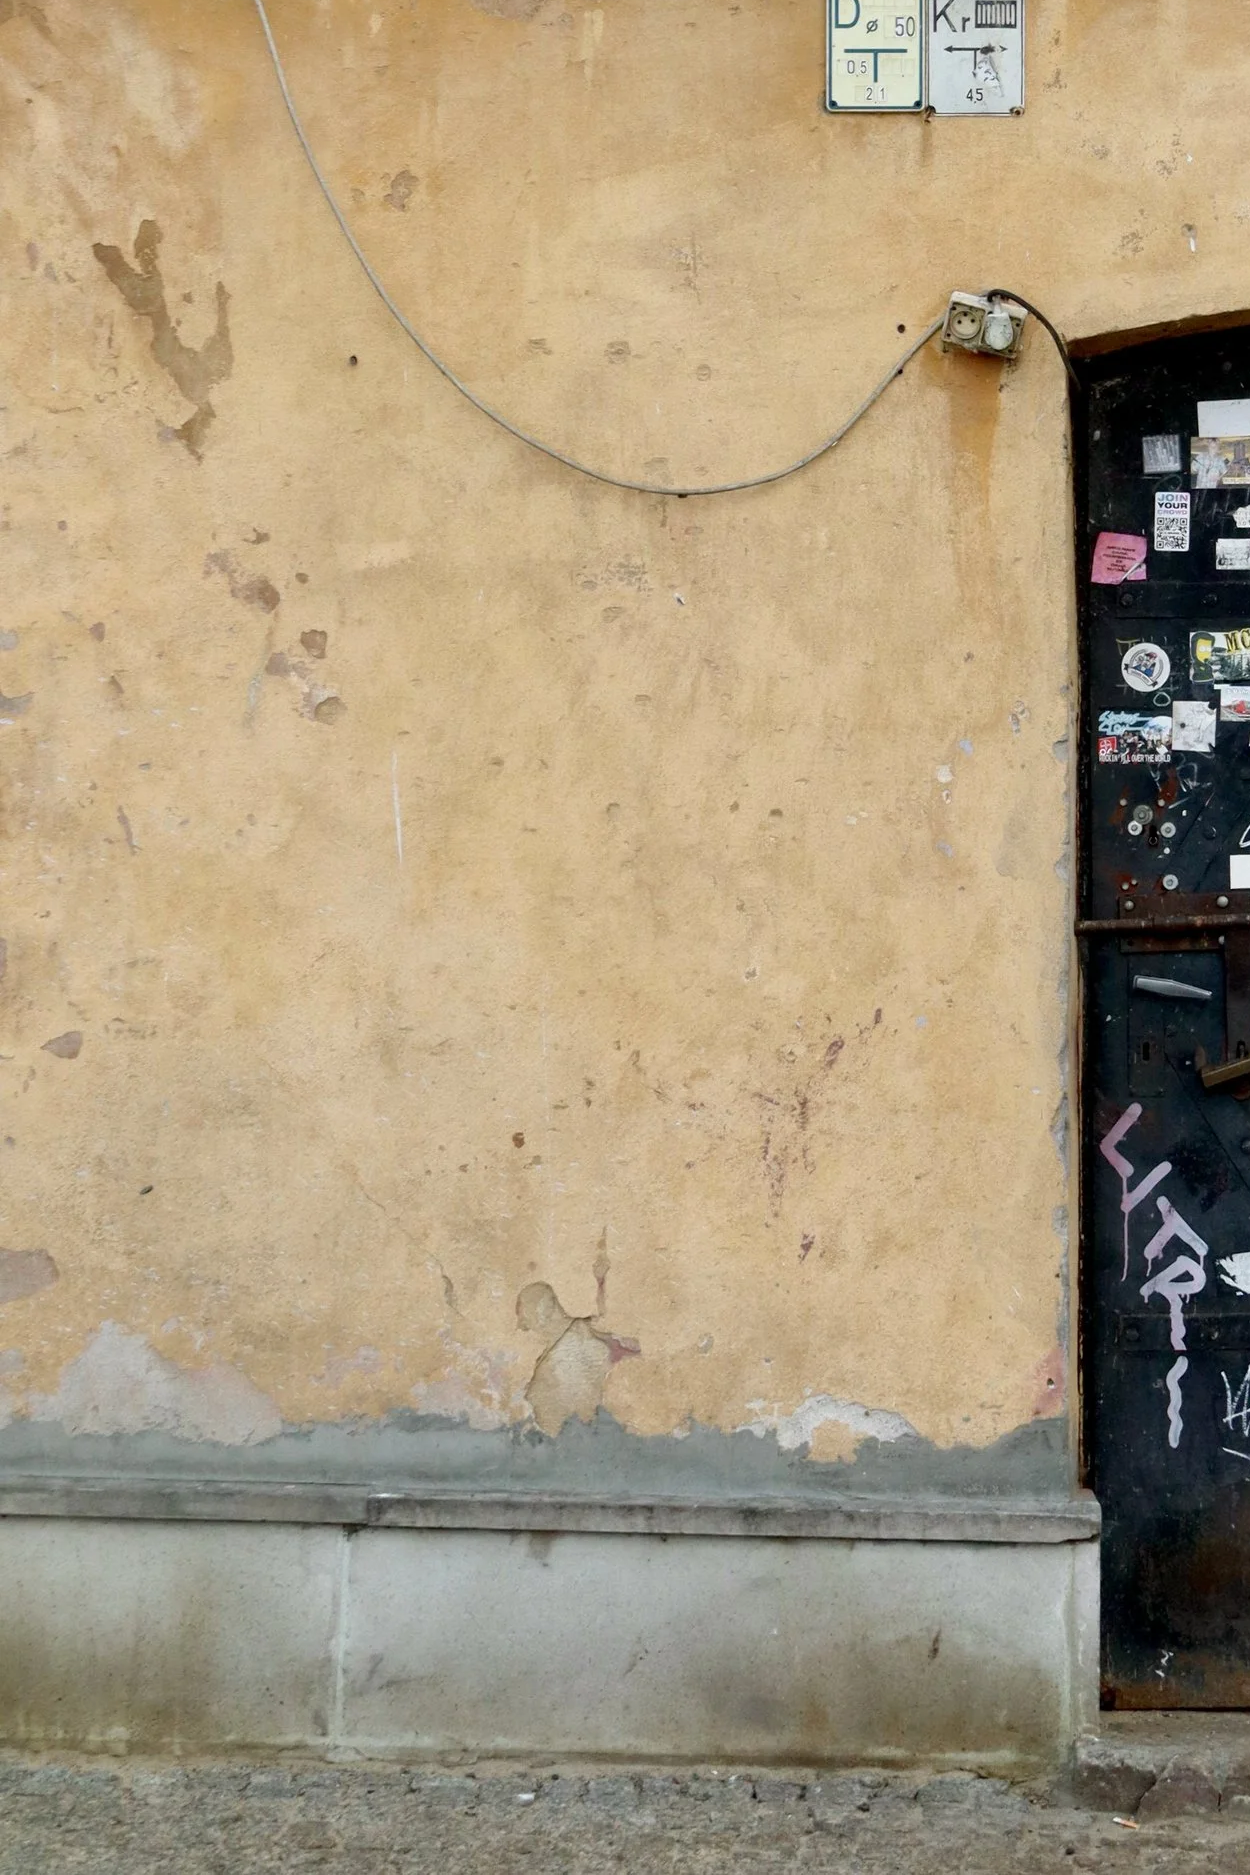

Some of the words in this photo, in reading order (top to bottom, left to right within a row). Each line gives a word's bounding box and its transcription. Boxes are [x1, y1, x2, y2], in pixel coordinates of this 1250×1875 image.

[894, 15, 916, 37] 50
[1157, 493, 1188, 502] JOIN
[1156, 502, 1188, 510] YOUR
